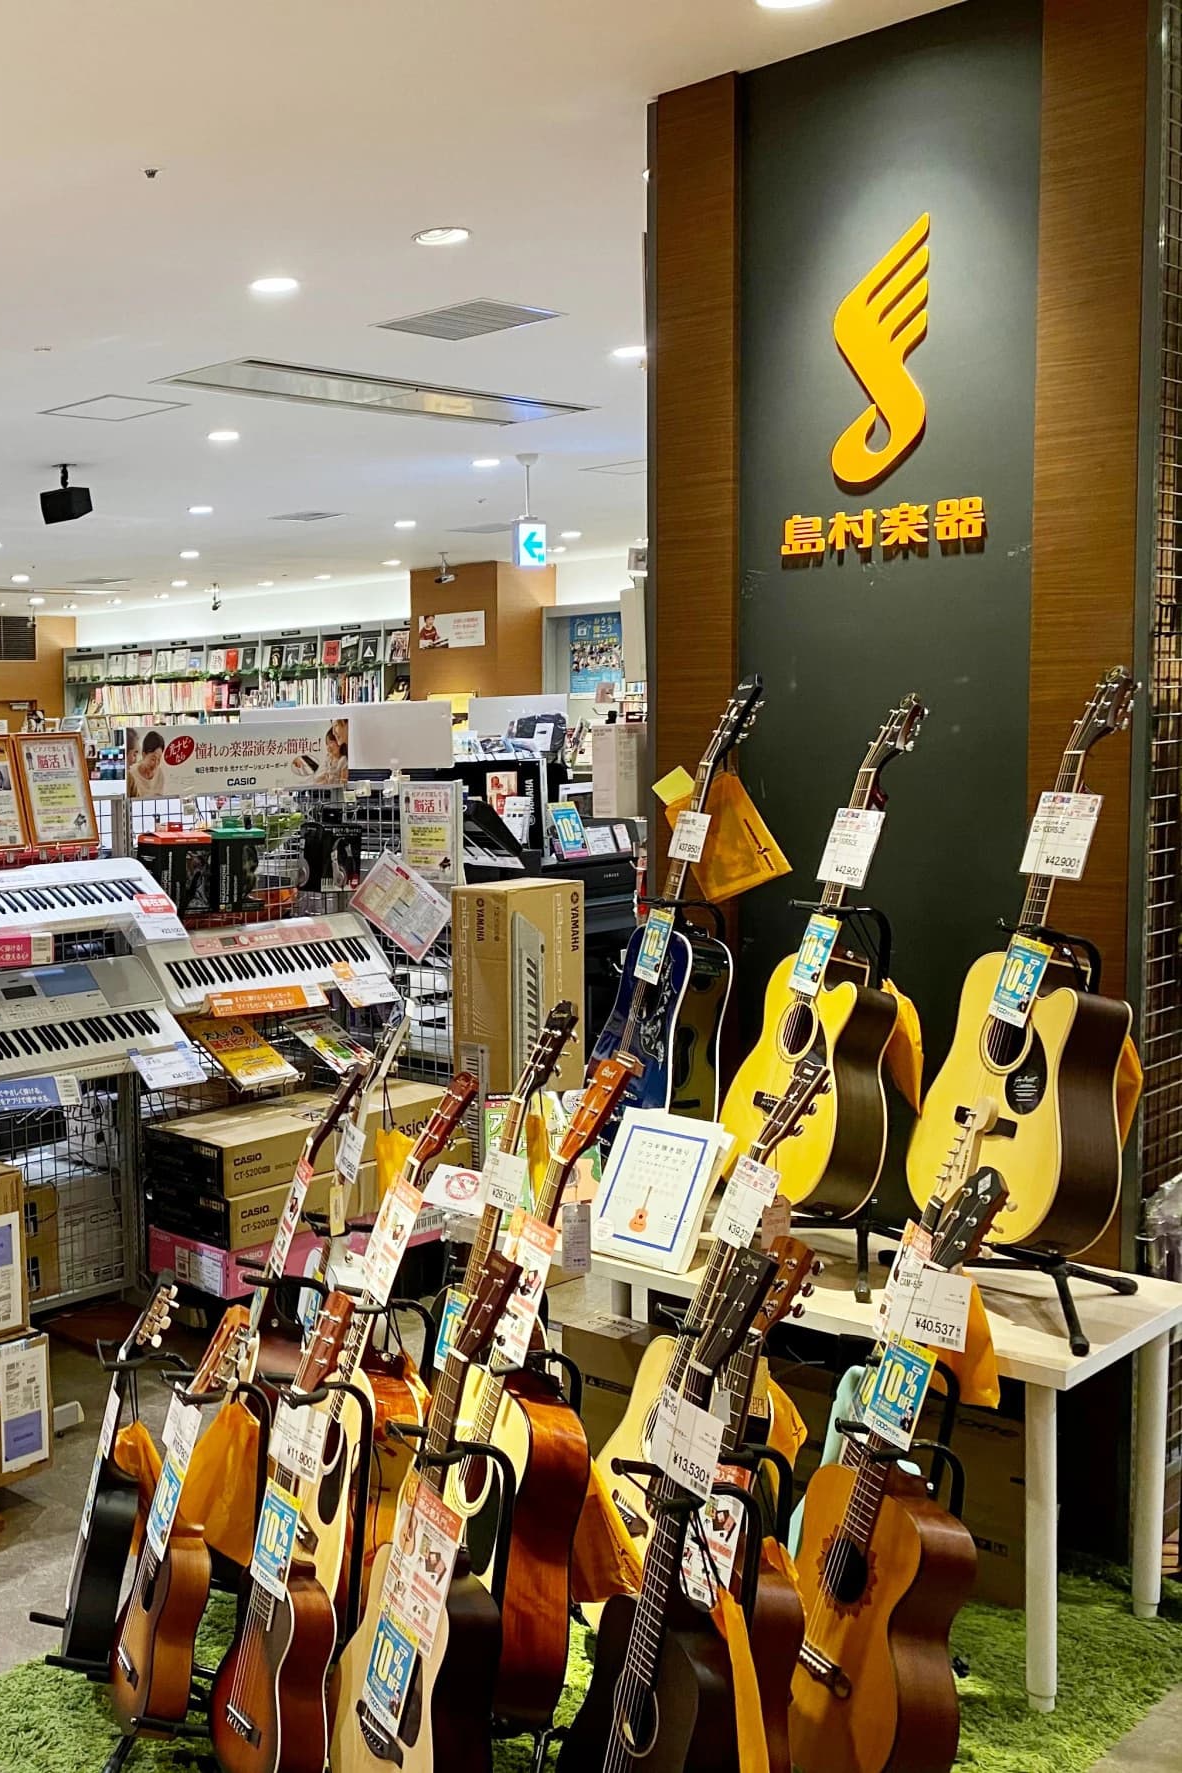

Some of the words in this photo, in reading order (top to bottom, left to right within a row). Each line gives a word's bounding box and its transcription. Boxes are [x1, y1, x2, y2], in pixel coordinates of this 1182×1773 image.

[780, 496, 986, 556] 島村楽器
[195, 738, 322, 760] 憧れの楽器演奏が簡単に!
[227, 777, 257, 787] CASIO
[1045, 855, 1077, 868] ¥42,900
[476, 909, 486, 942] YAMAHA
[571, 907, 579, 952] YAMAHA
[233, 1152, 263, 1167] CASIO
[240, 1204, 270, 1219] CASIO
[915, 1316, 956, 1337] ¥40,537
[672, 1452, 706, 1483] ¥13,530
